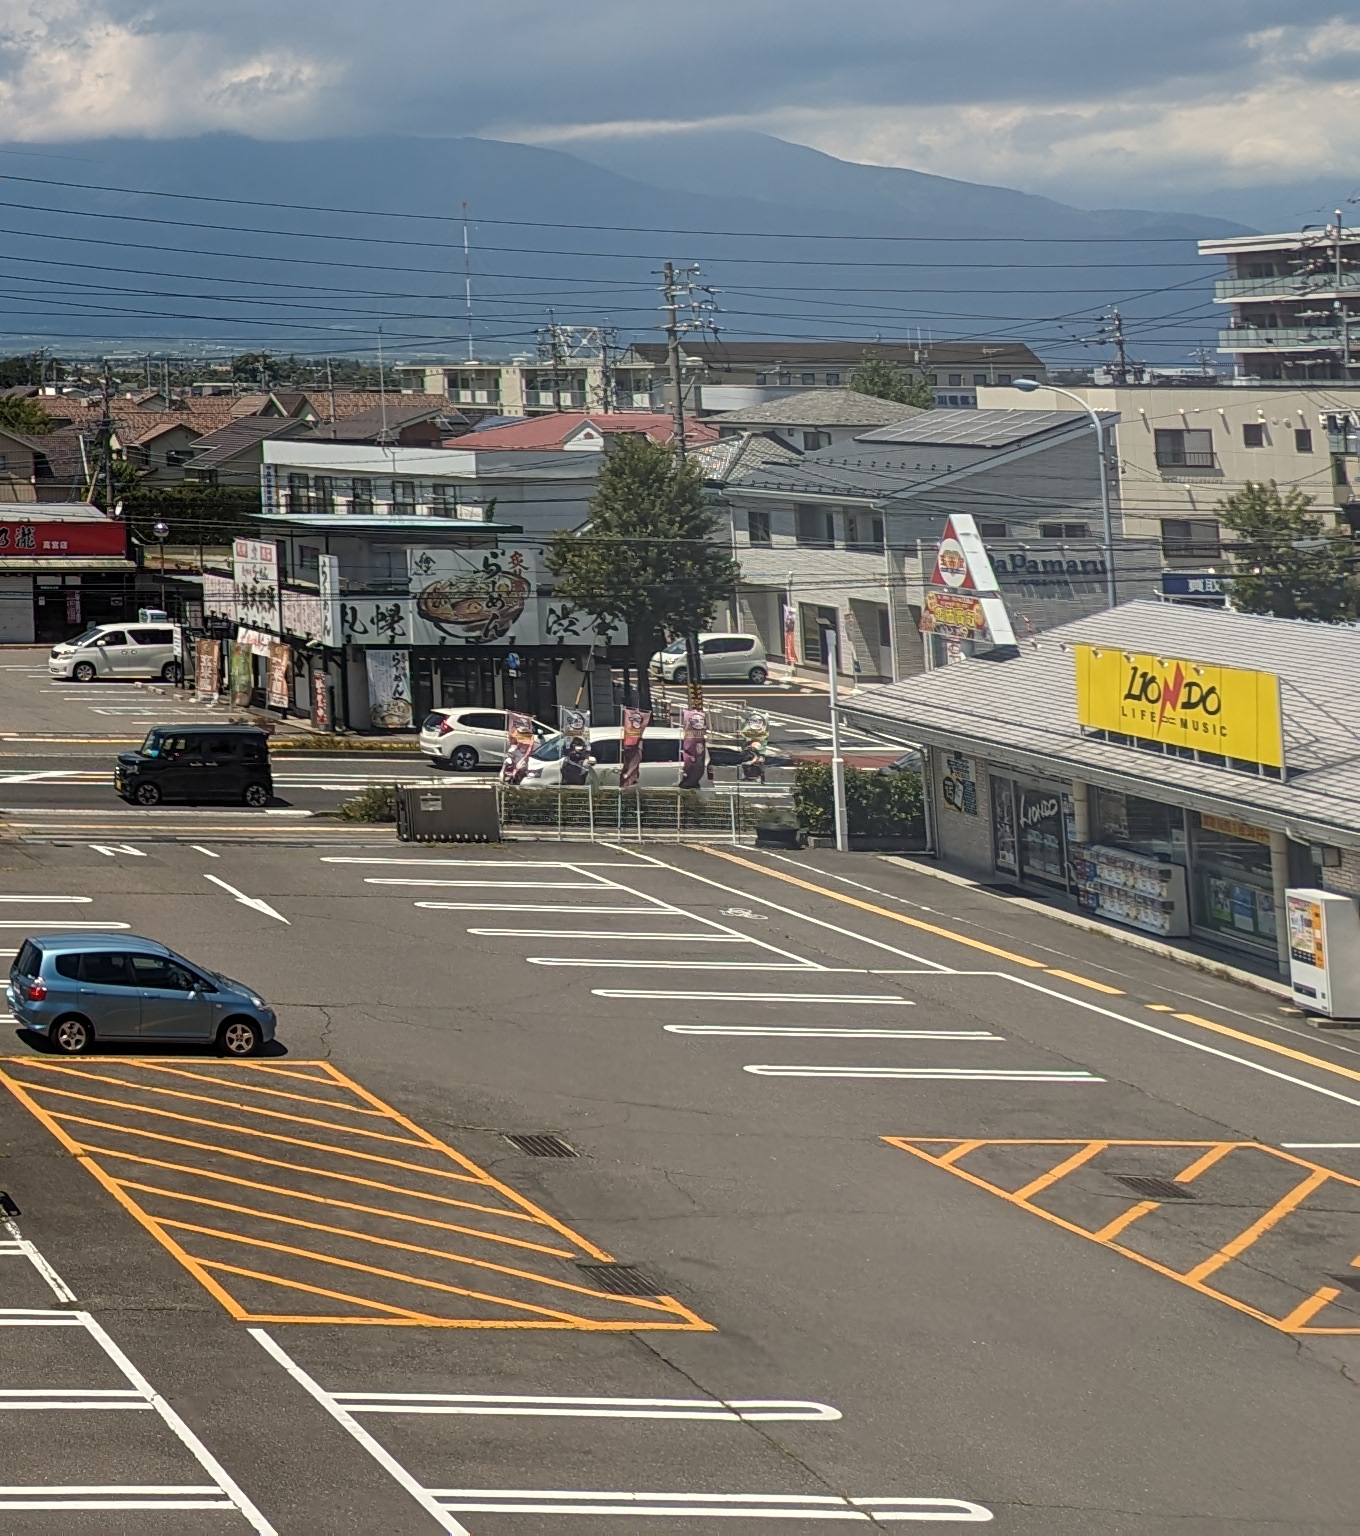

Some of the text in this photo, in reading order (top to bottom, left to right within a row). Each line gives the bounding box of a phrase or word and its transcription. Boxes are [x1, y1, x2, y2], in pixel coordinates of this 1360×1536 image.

[1123, 661, 1222, 717] LIONDO
[1121, 705, 1228, 737] LIFE MUSIC
